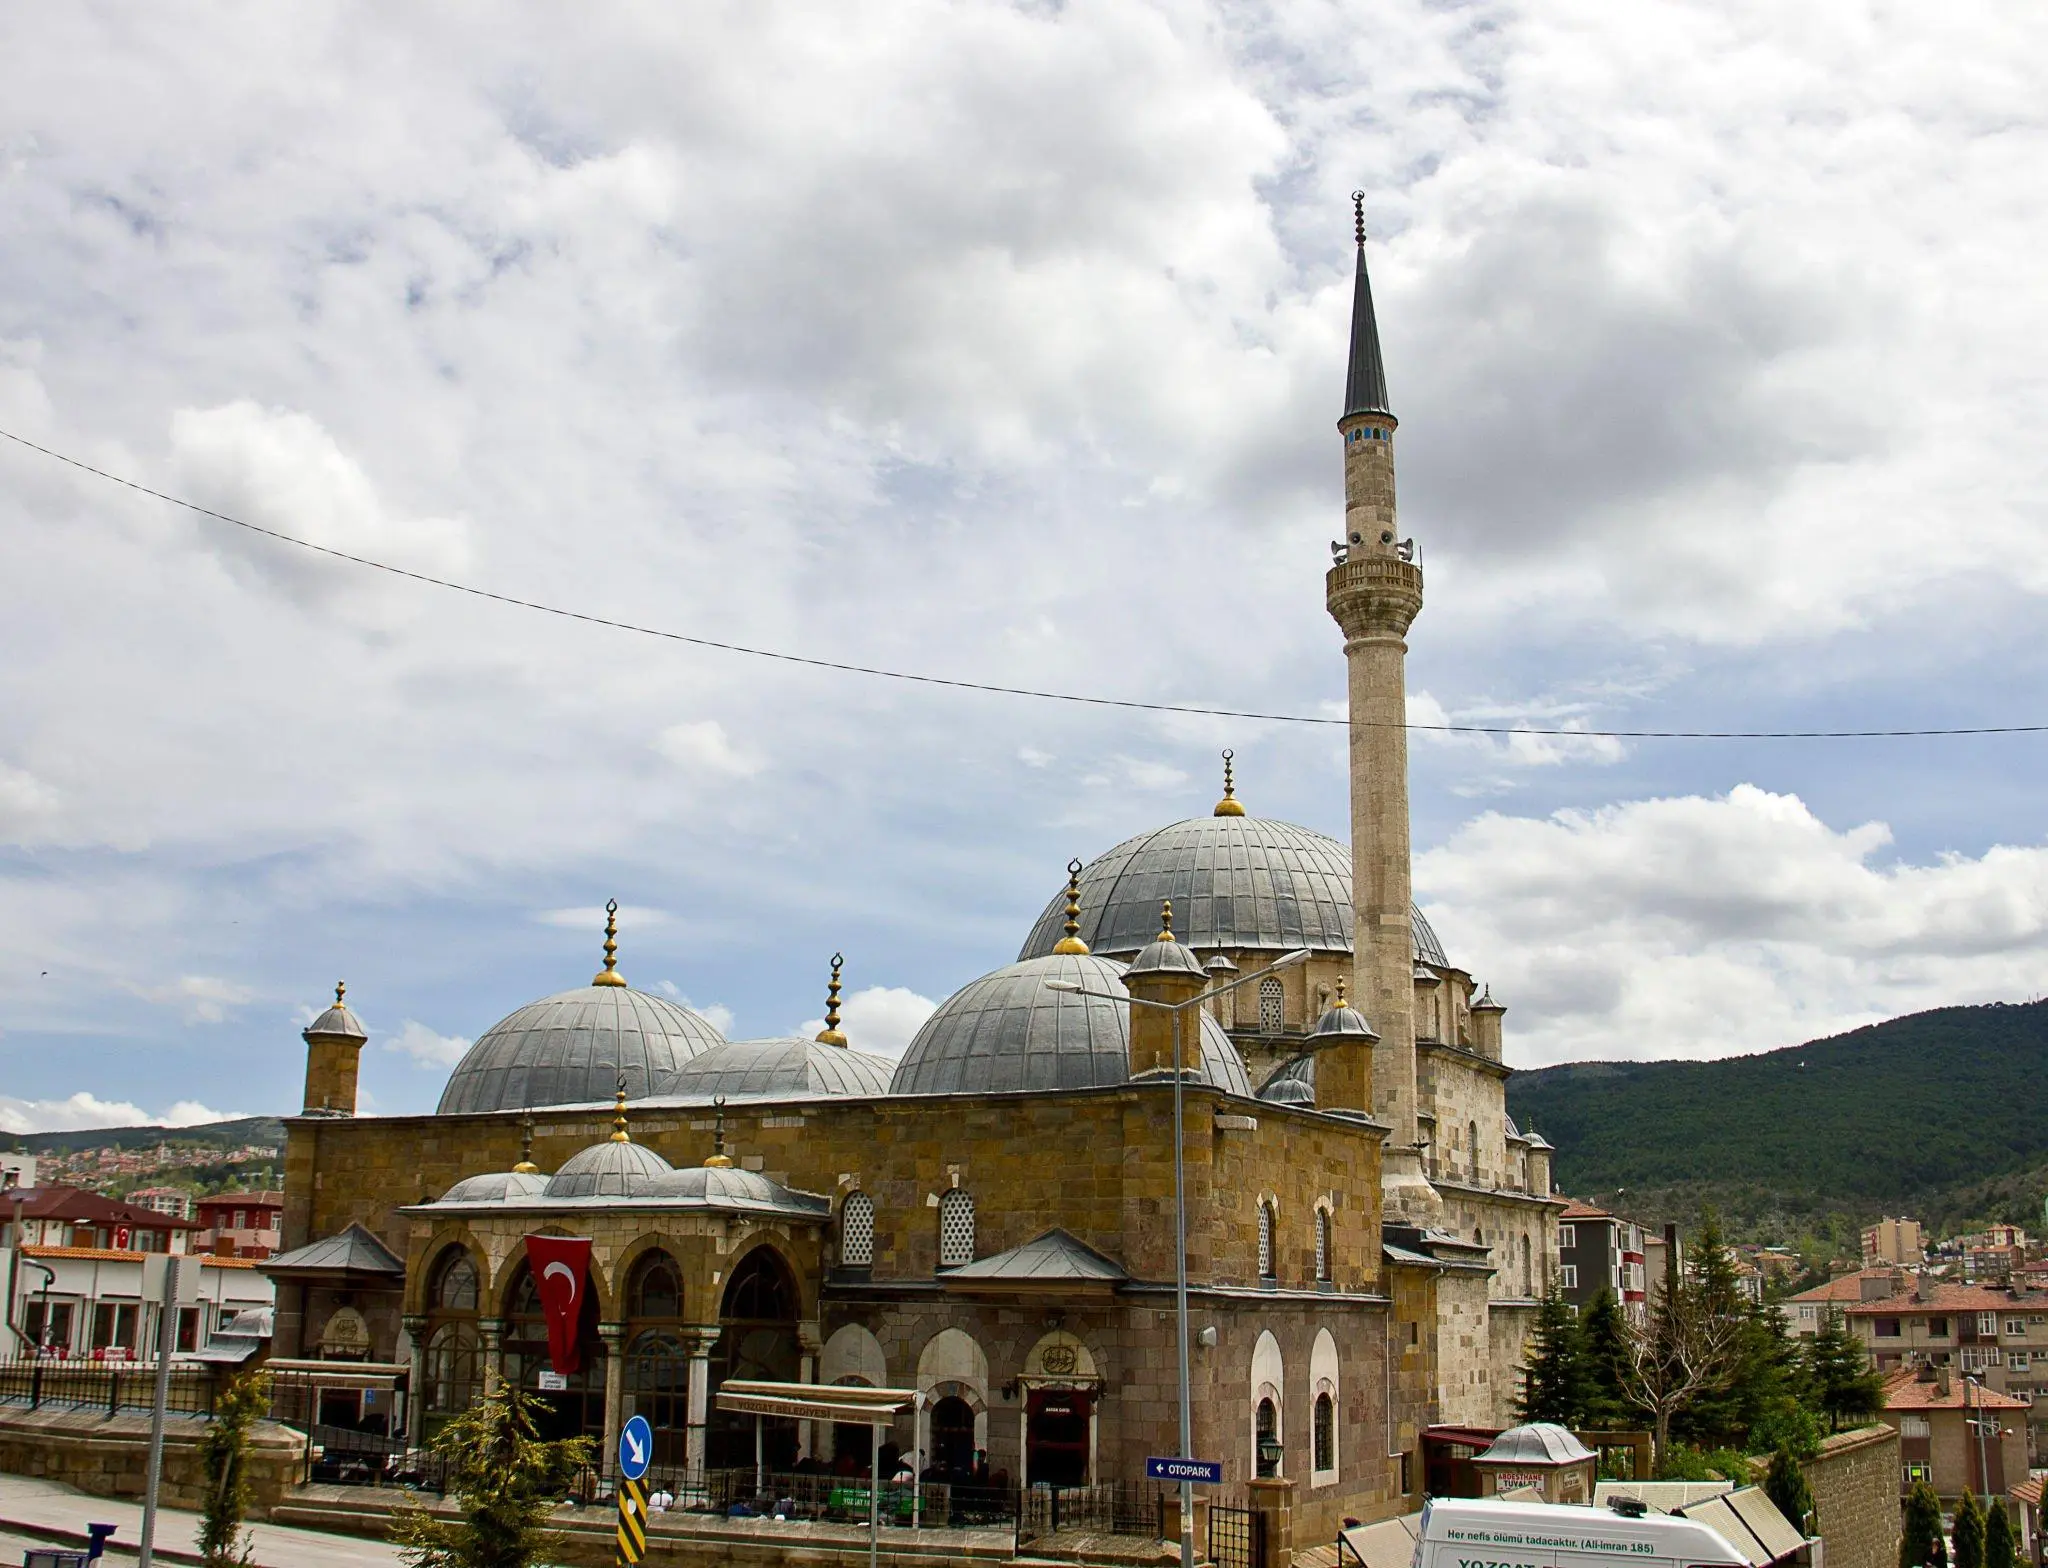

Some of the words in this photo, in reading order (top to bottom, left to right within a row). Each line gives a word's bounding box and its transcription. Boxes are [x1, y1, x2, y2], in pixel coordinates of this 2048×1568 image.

[1168, 1464, 1211, 1478] OTOPARK
[1498, 1473, 1542, 1481] ABDESTHANE
[1447, 1529, 1465, 1540] Her
[1467, 1531, 1491, 1542] nefis
[1493, 1531, 1523, 1544] ölümü
[1525, 1534, 1578, 1549] tadacaktır.
[1630, 1542, 1654, 1555] 185)
